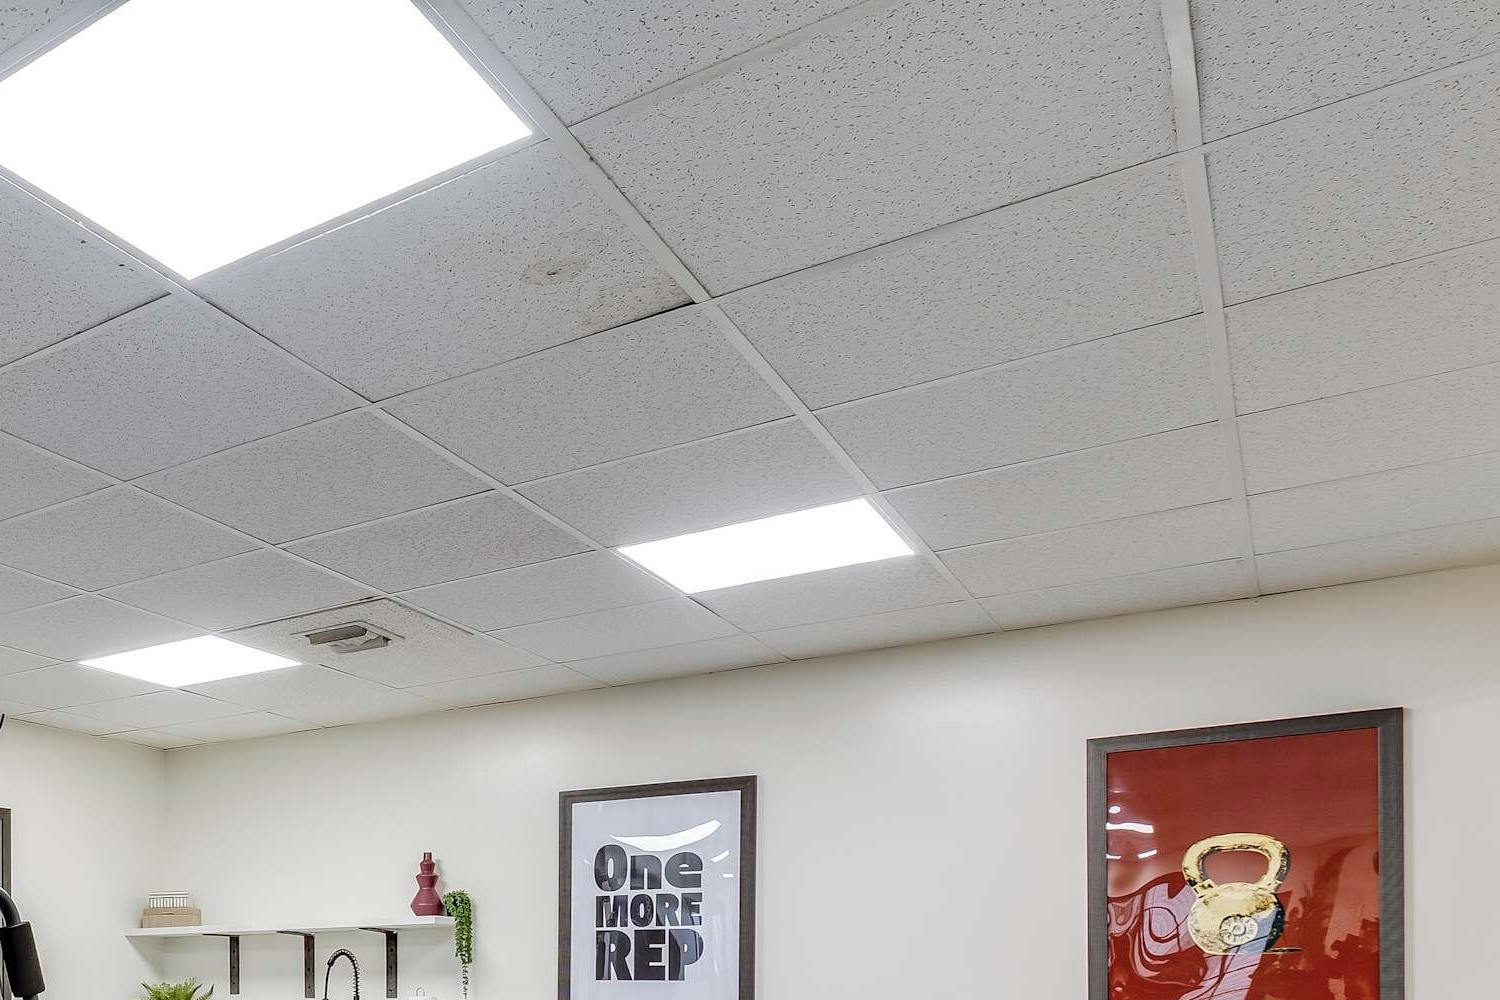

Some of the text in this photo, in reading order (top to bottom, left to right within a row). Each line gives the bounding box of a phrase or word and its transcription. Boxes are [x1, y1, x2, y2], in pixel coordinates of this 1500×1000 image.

[594, 844, 703, 891] One
[596, 892, 702, 927] MORE
[596, 929, 704, 981] REP
